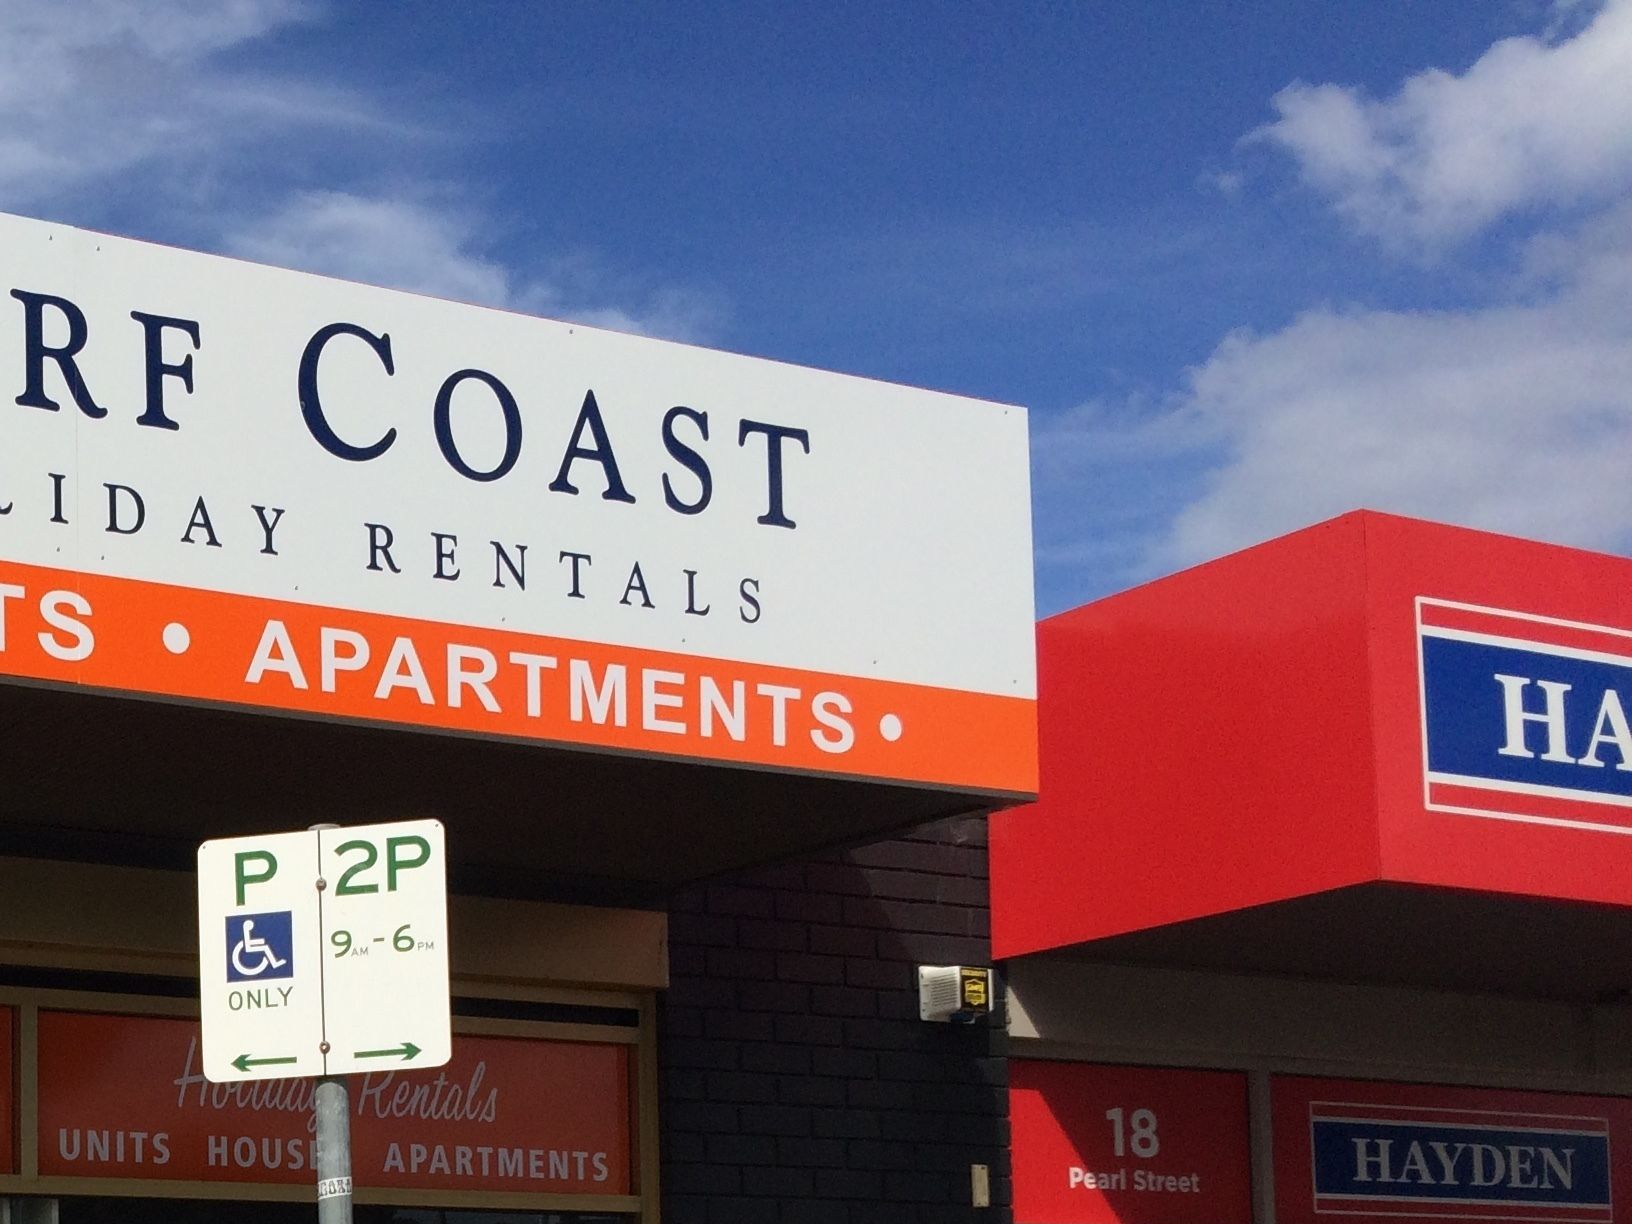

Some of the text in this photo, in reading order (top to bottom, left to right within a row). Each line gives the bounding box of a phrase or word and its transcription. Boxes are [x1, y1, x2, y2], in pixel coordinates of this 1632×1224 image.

[298, 321, 810, 529] COAST
[365, 522, 763, 624] RENTALS
[244, 620, 856, 754] APARTMENTS
[1494, 673, 1632, 772] HA
[235, 834, 431, 906] P 2P
[228, 986, 294, 1011] ONLY
[358, 1061, 497, 1122] Rentals
[59, 1127, 608, 1181] UNITS HOUS APARTMENTS
[1105, 1107, 1161, 1158] 18
[1069, 1166, 1201, 1194] Pearl Street
[1351, 1136, 1576, 1192] HAYDEN
